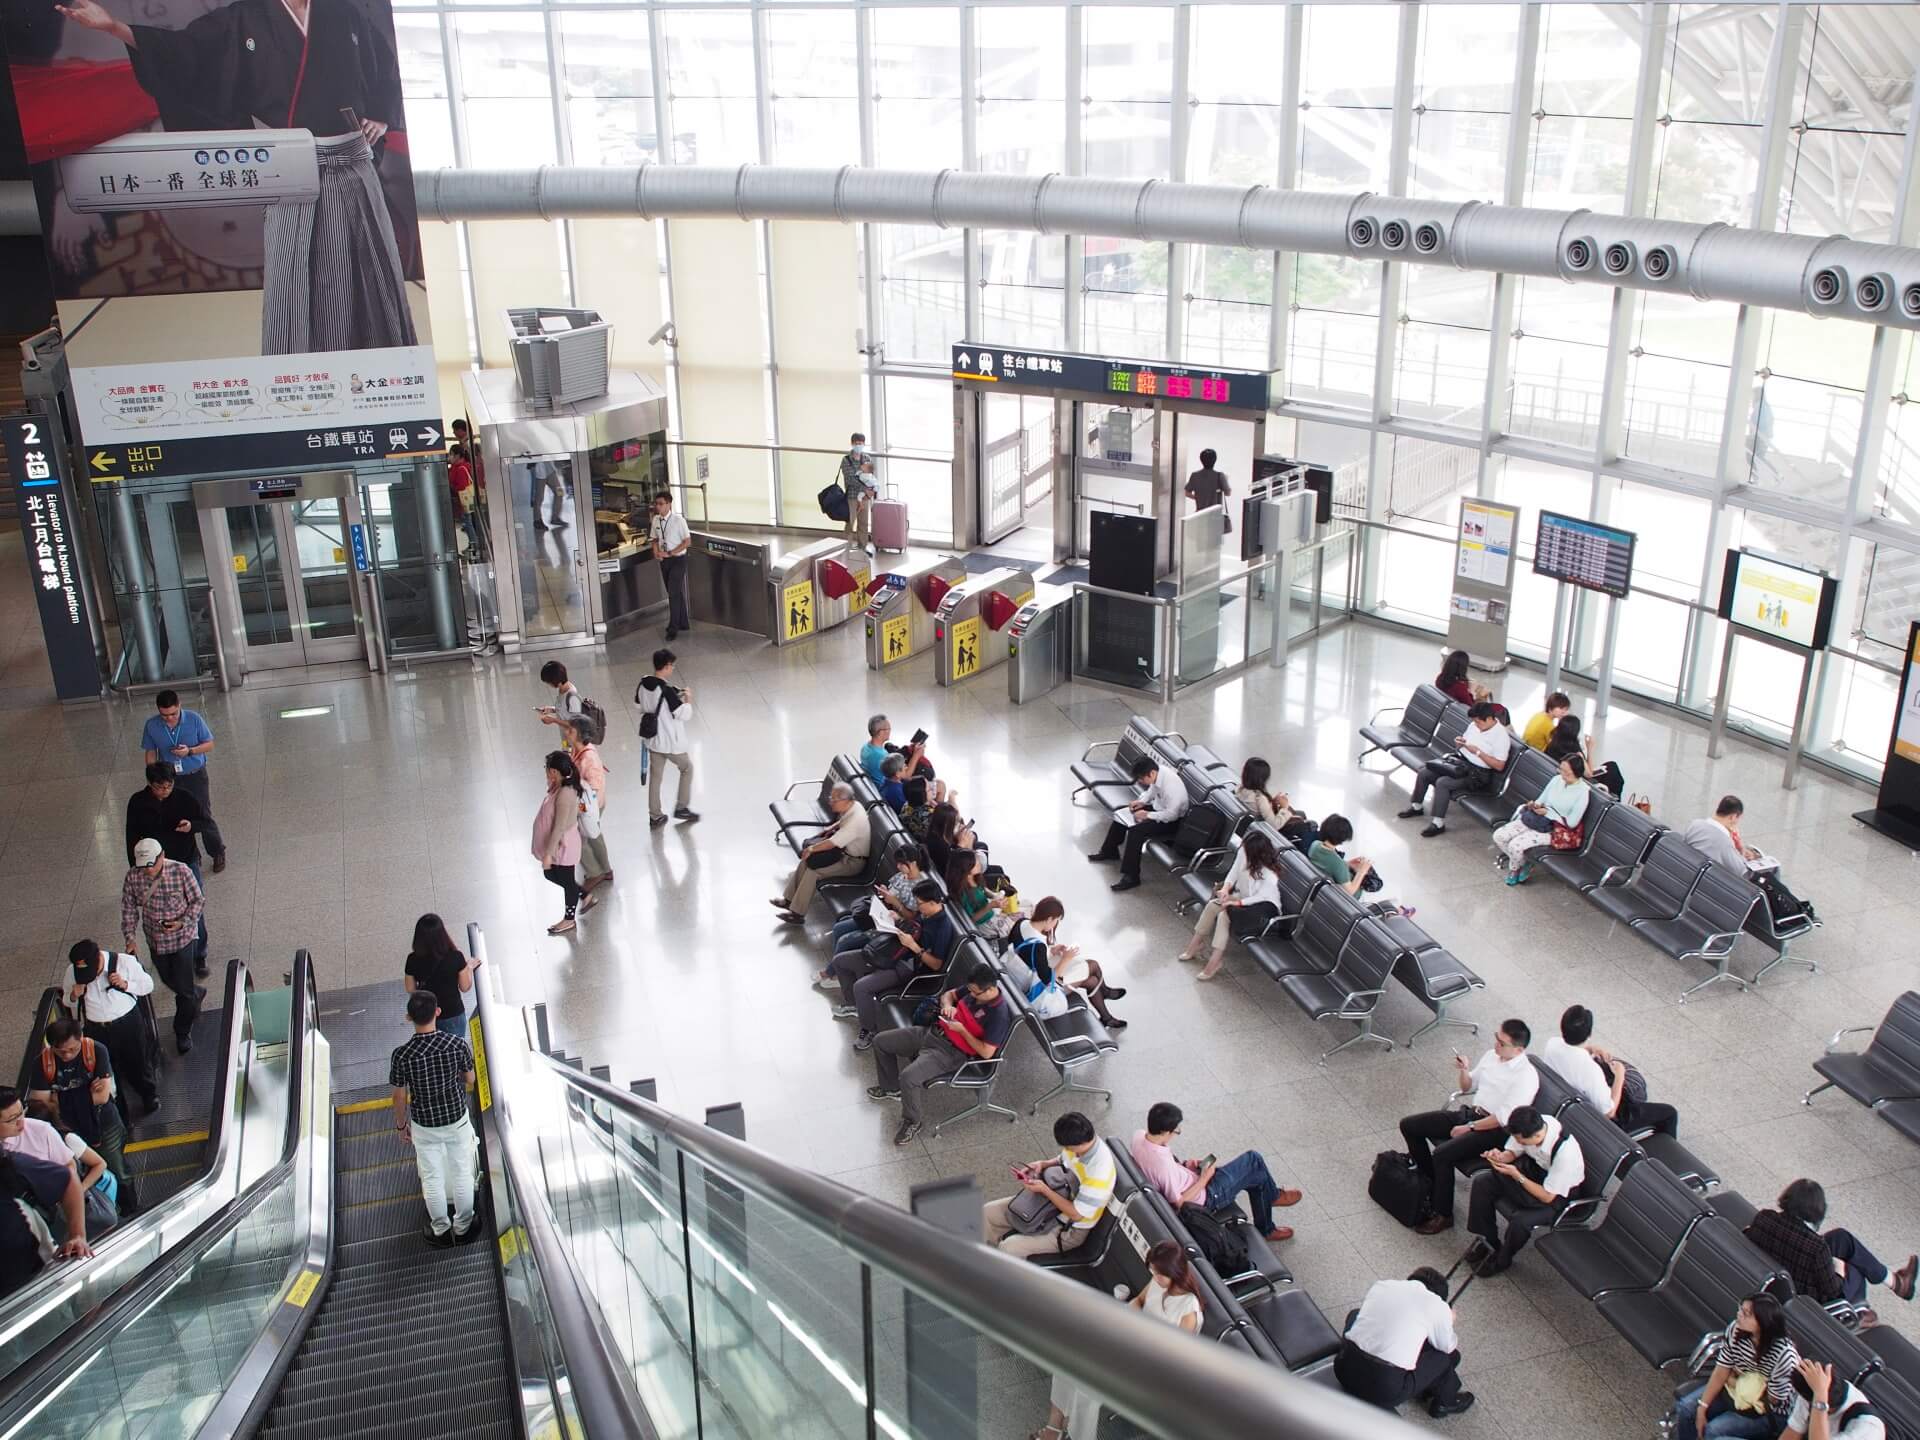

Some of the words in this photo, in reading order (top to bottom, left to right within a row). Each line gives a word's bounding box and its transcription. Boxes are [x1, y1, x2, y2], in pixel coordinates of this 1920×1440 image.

[99, 171, 185, 194] 日本一番
[197, 169, 281, 190] 全球第一
[1002, 369, 1017, 378] TRA
[192, 380, 220, 390] 用大金
[223, 378, 249, 388] 省大金
[20, 422, 41, 445] 2
[306, 430, 374, 449] 台鐵車站
[127, 445, 162, 462] 出口
[353, 446, 376, 455] TRA
[130, 462, 156, 472] Exit
[256, 480, 265, 489] 2
[46, 494, 62, 533] Elevator
[54, 533, 65, 543] to
[57, 544, 74, 586] N.bound
[63, 585, 81, 624] platform
